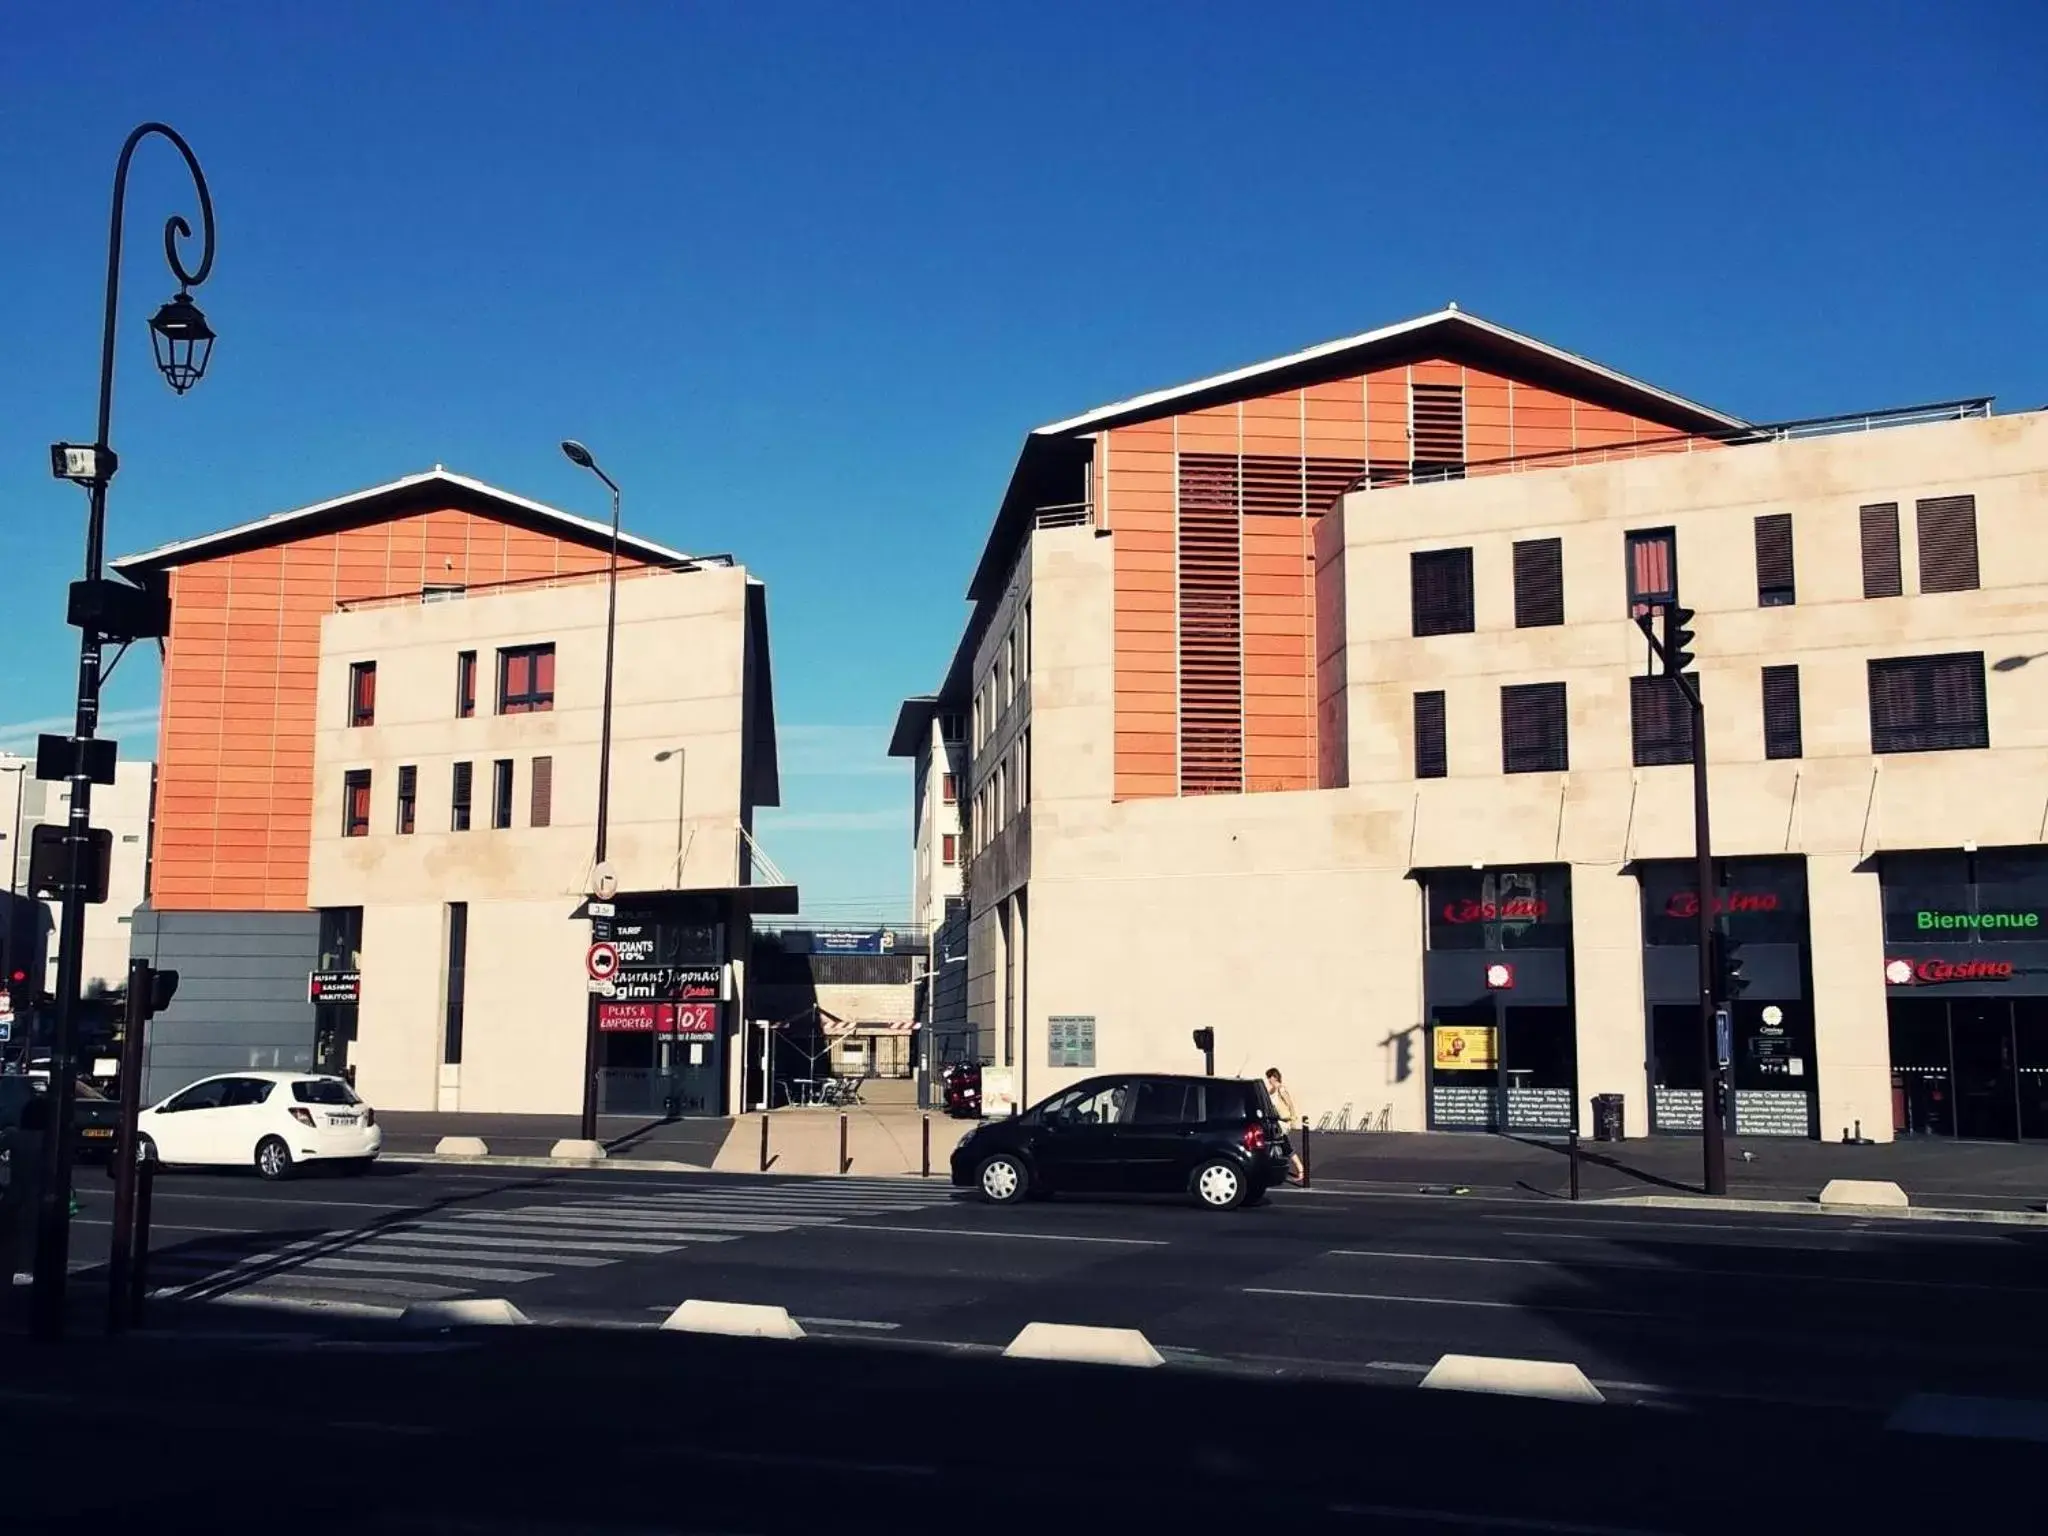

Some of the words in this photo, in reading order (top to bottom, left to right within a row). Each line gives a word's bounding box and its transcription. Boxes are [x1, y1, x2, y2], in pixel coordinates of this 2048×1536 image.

[1917, 911, 2039, 929] Bienvenue
[616, 926, 642, 935] TARIF
[1917, 959, 2014, 981] Casino
